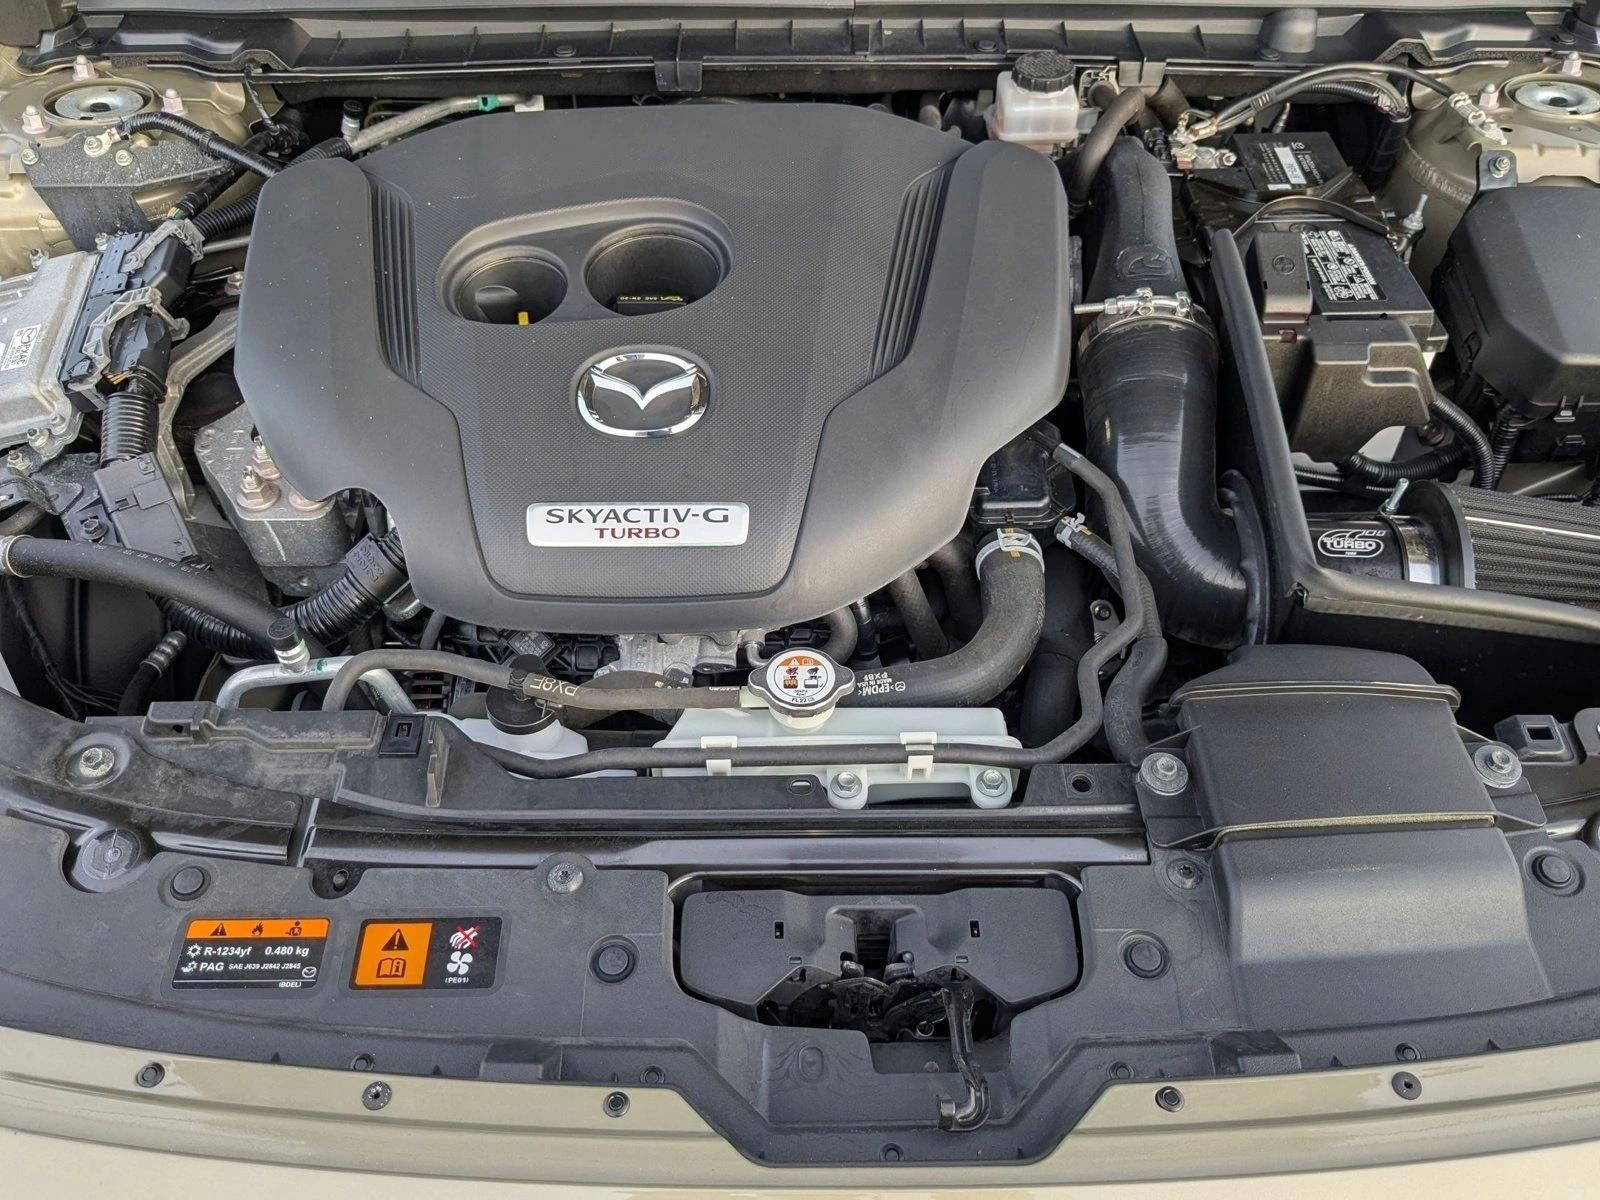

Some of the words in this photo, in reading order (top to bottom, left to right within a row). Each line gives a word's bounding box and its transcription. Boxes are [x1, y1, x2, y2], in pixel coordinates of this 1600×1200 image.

[545, 507, 729, 523] SKYACTIV-G
[594, 527, 680, 539] TURBO
[1324, 540, 1376, 549] TURBO
[204, 945, 252, 957] R-1234yf
[264, 945, 293, 956] 0.480
[295, 945, 309, 958] kg
[200, 962, 224, 971] PAG
[281, 962, 301, 970] J2845
